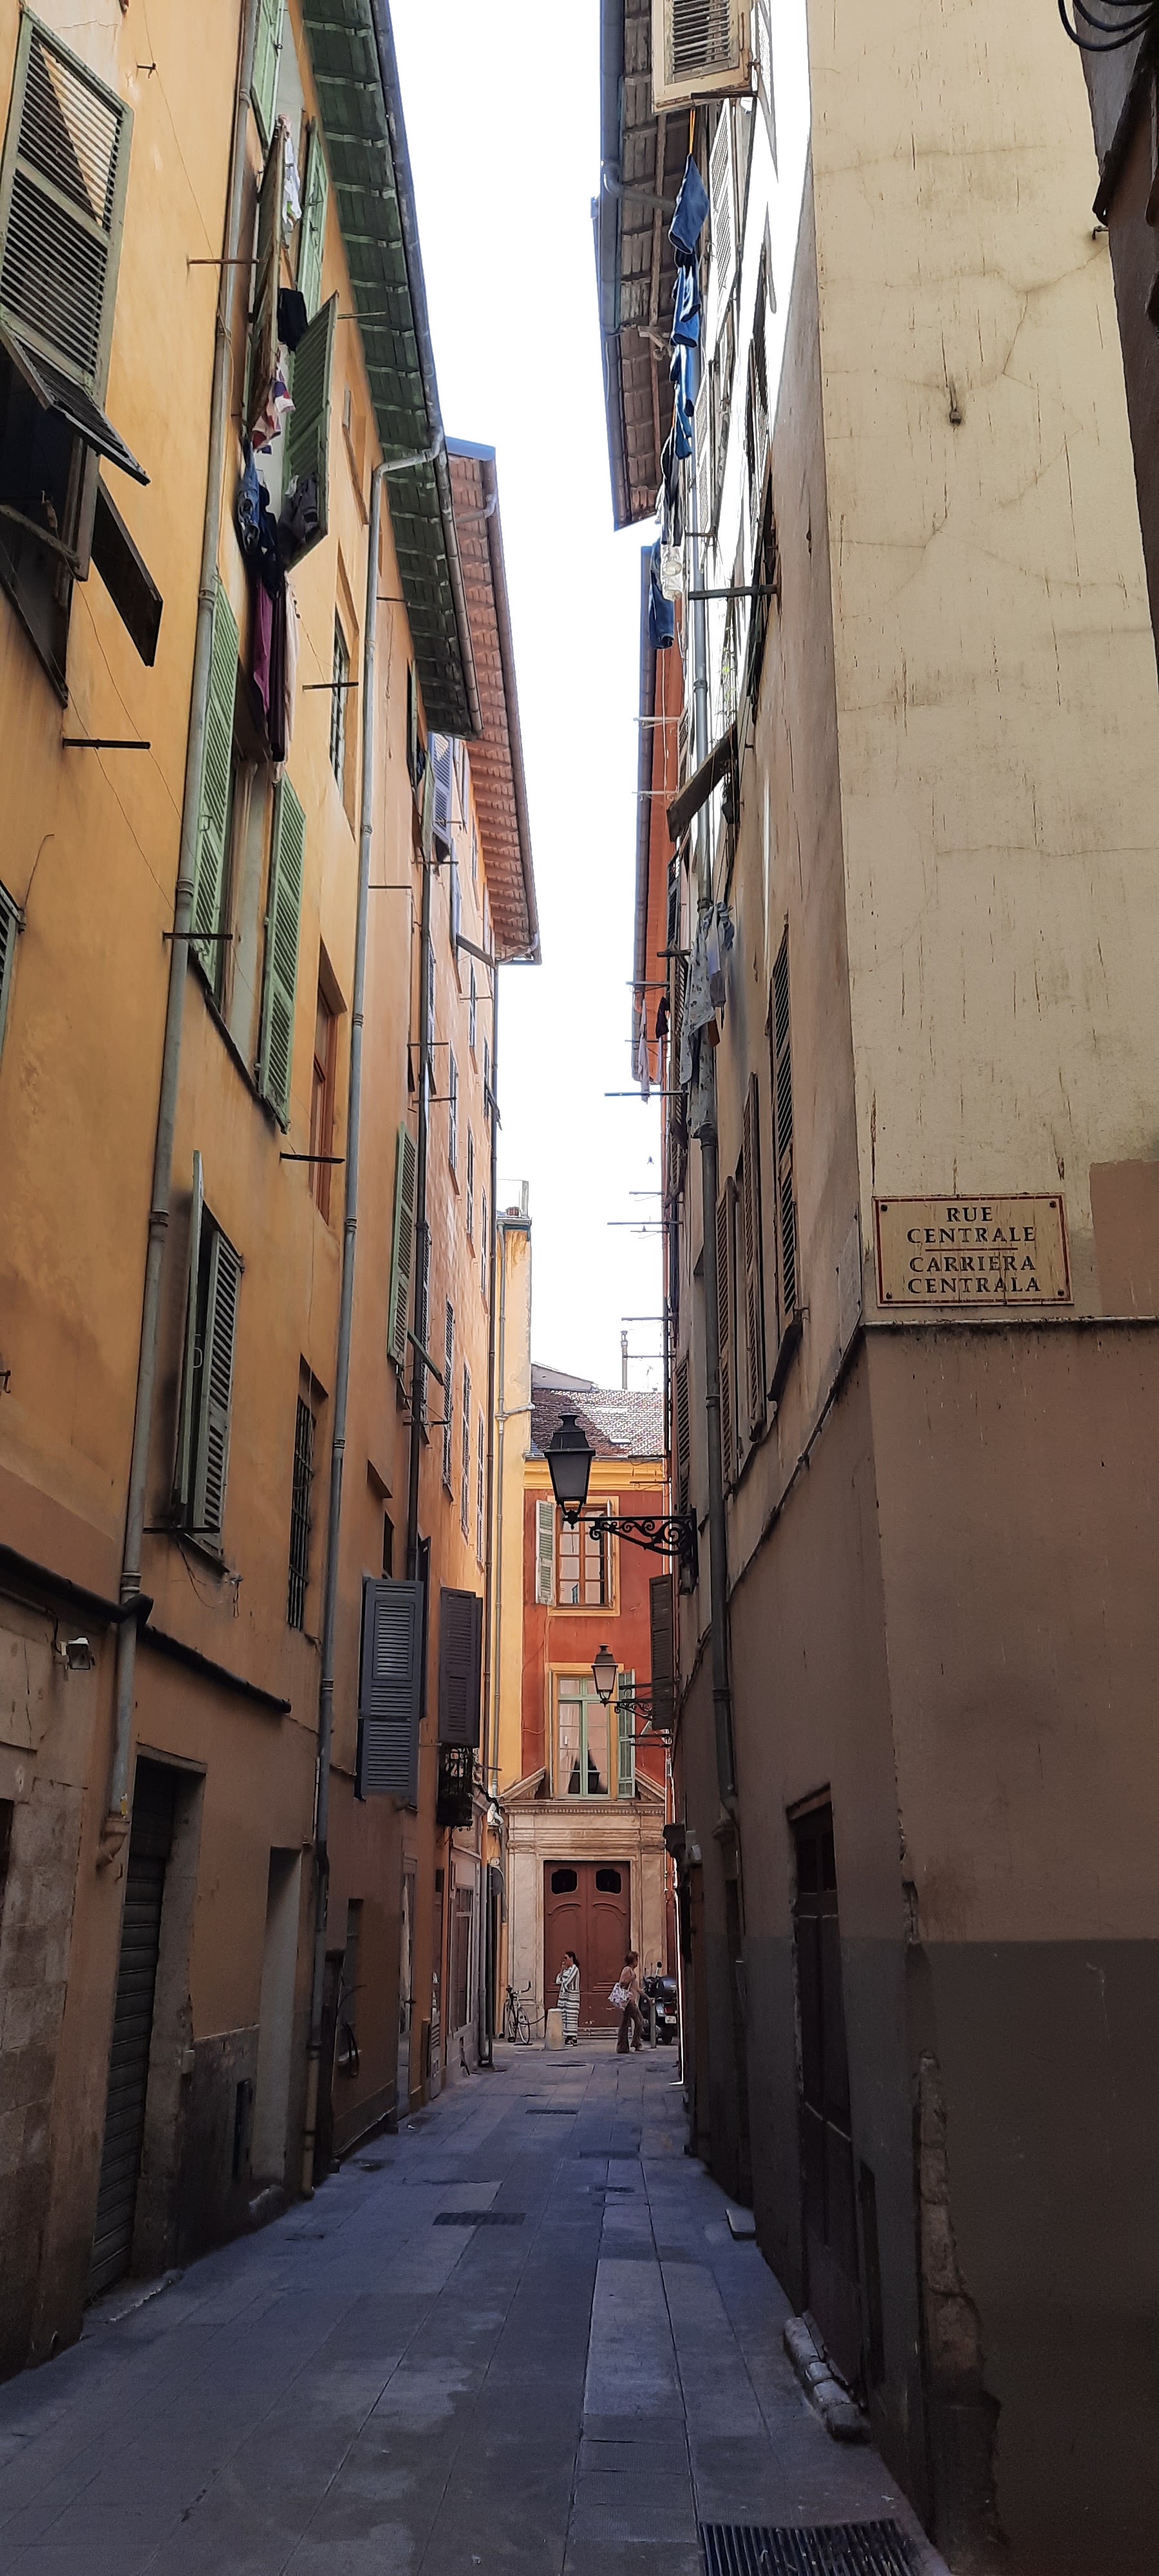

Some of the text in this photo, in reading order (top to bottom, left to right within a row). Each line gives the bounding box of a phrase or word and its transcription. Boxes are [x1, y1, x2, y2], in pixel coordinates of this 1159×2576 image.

[947, 1206, 993, 1222] RUE
[907, 1226, 1036, 1244] CENTRALE
[909, 1255, 1036, 1273] CARRIERA
[907, 1276, 1042, 1294] CENTRALA
